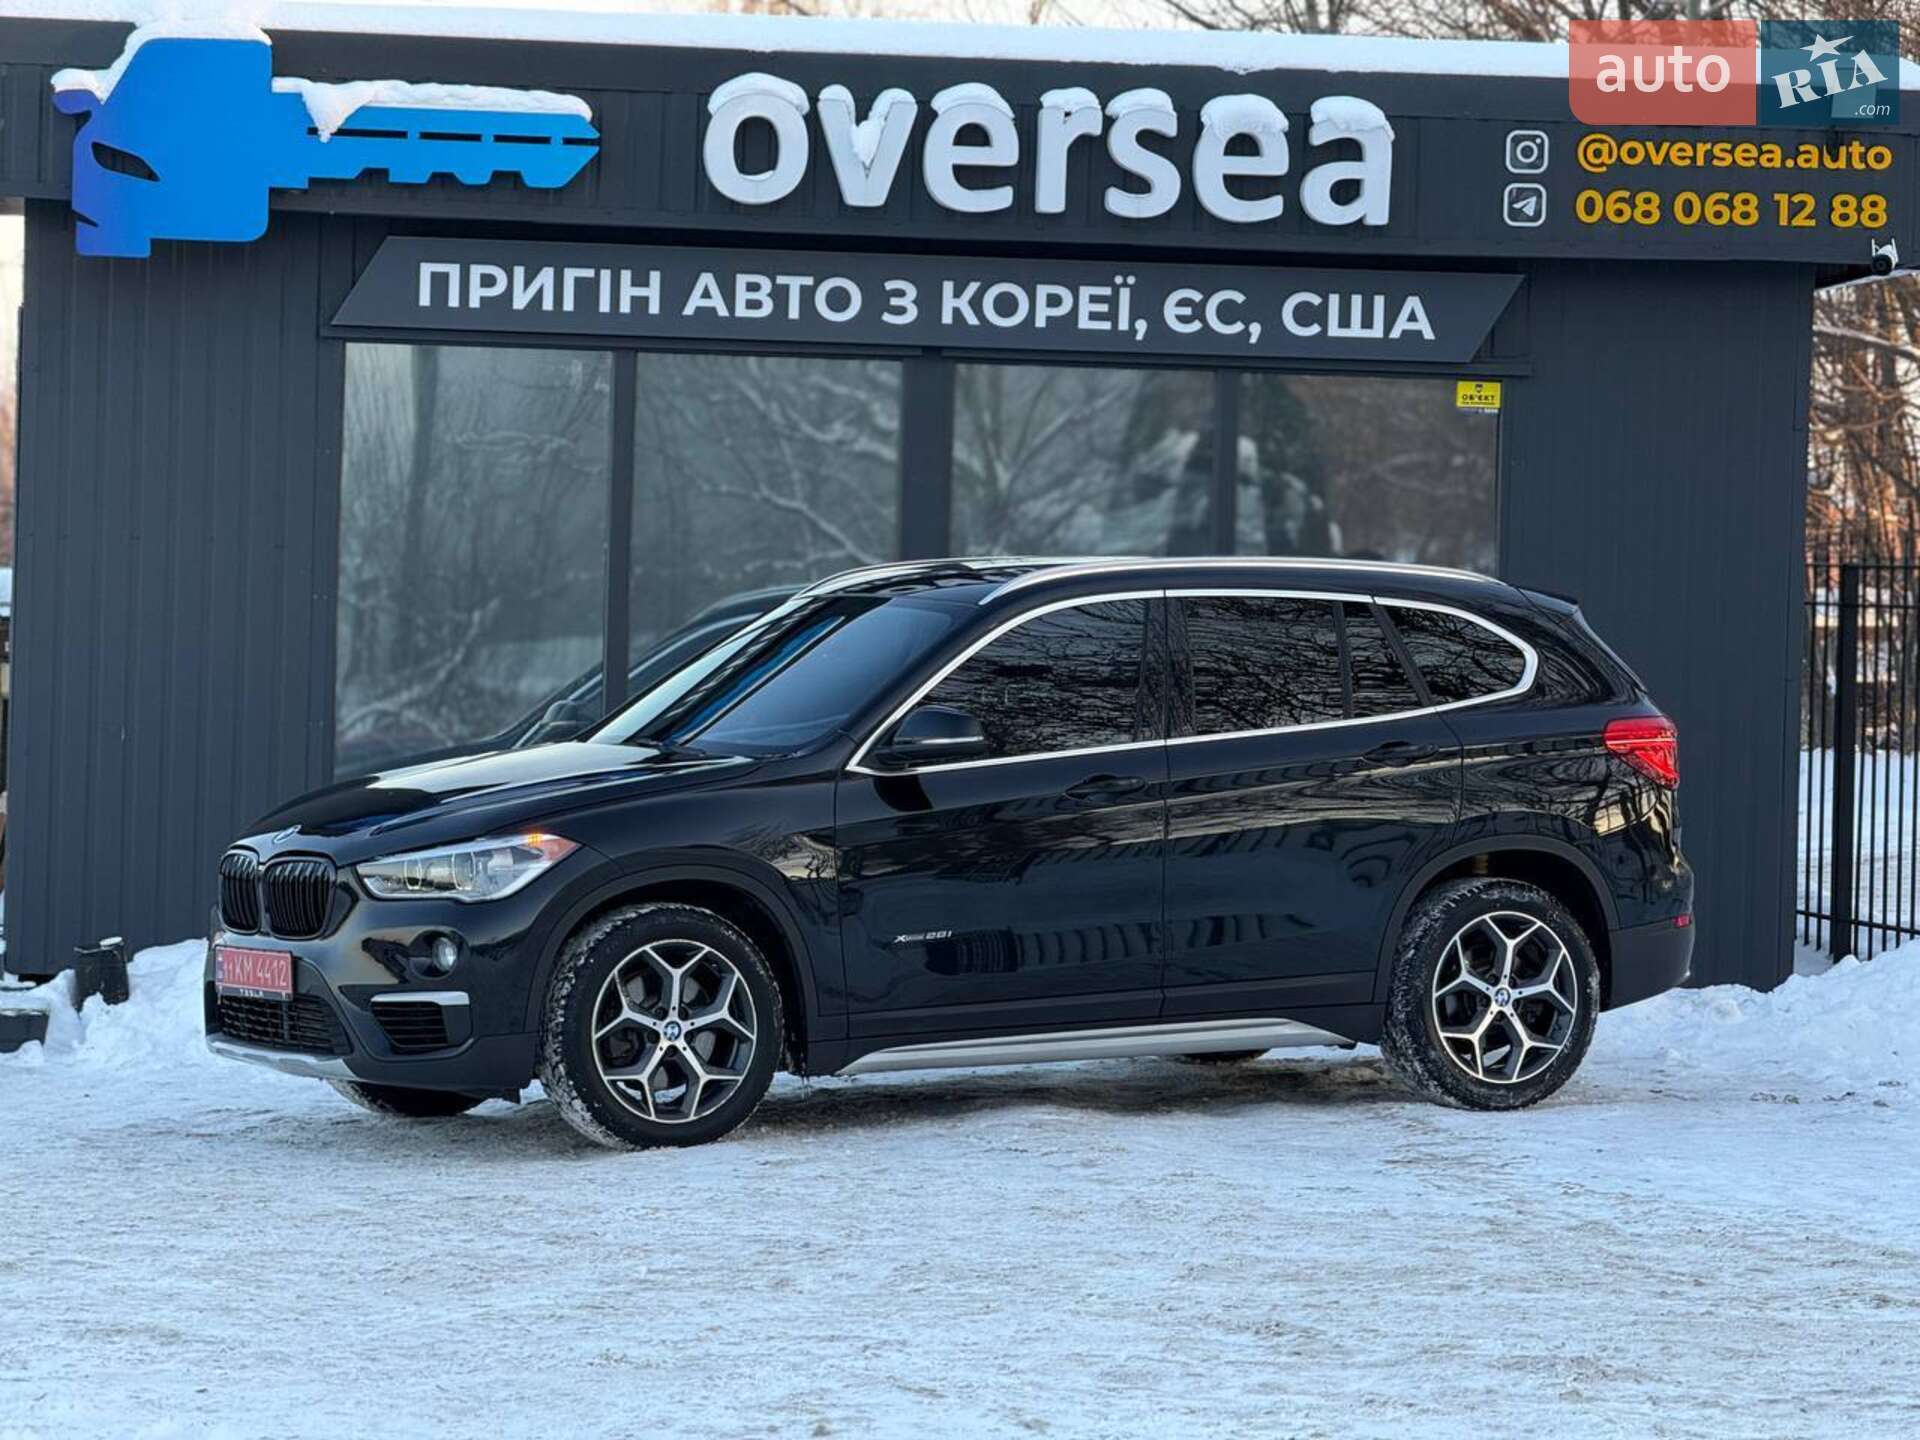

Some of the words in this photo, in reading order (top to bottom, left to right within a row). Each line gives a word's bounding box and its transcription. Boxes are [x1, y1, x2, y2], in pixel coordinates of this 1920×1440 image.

[703, 75, 1394, 227] oversea
[1576, 133, 1894, 173] @oversea.auto
[1575, 189, 1661, 225] 068
[1673, 191, 1760, 227] 068
[1773, 192, 1817, 228] 12
[1830, 193, 1889, 229] 88
[418, 261, 662, 315] ПРИГІН
[681, 271, 864, 323] АВТО
[880, 278, 919, 325] З
[941, 274, 1148, 341] КОРЕЇ,
[1163, 287, 1263, 345] ЄС,
[1281, 291, 1436, 341] США
